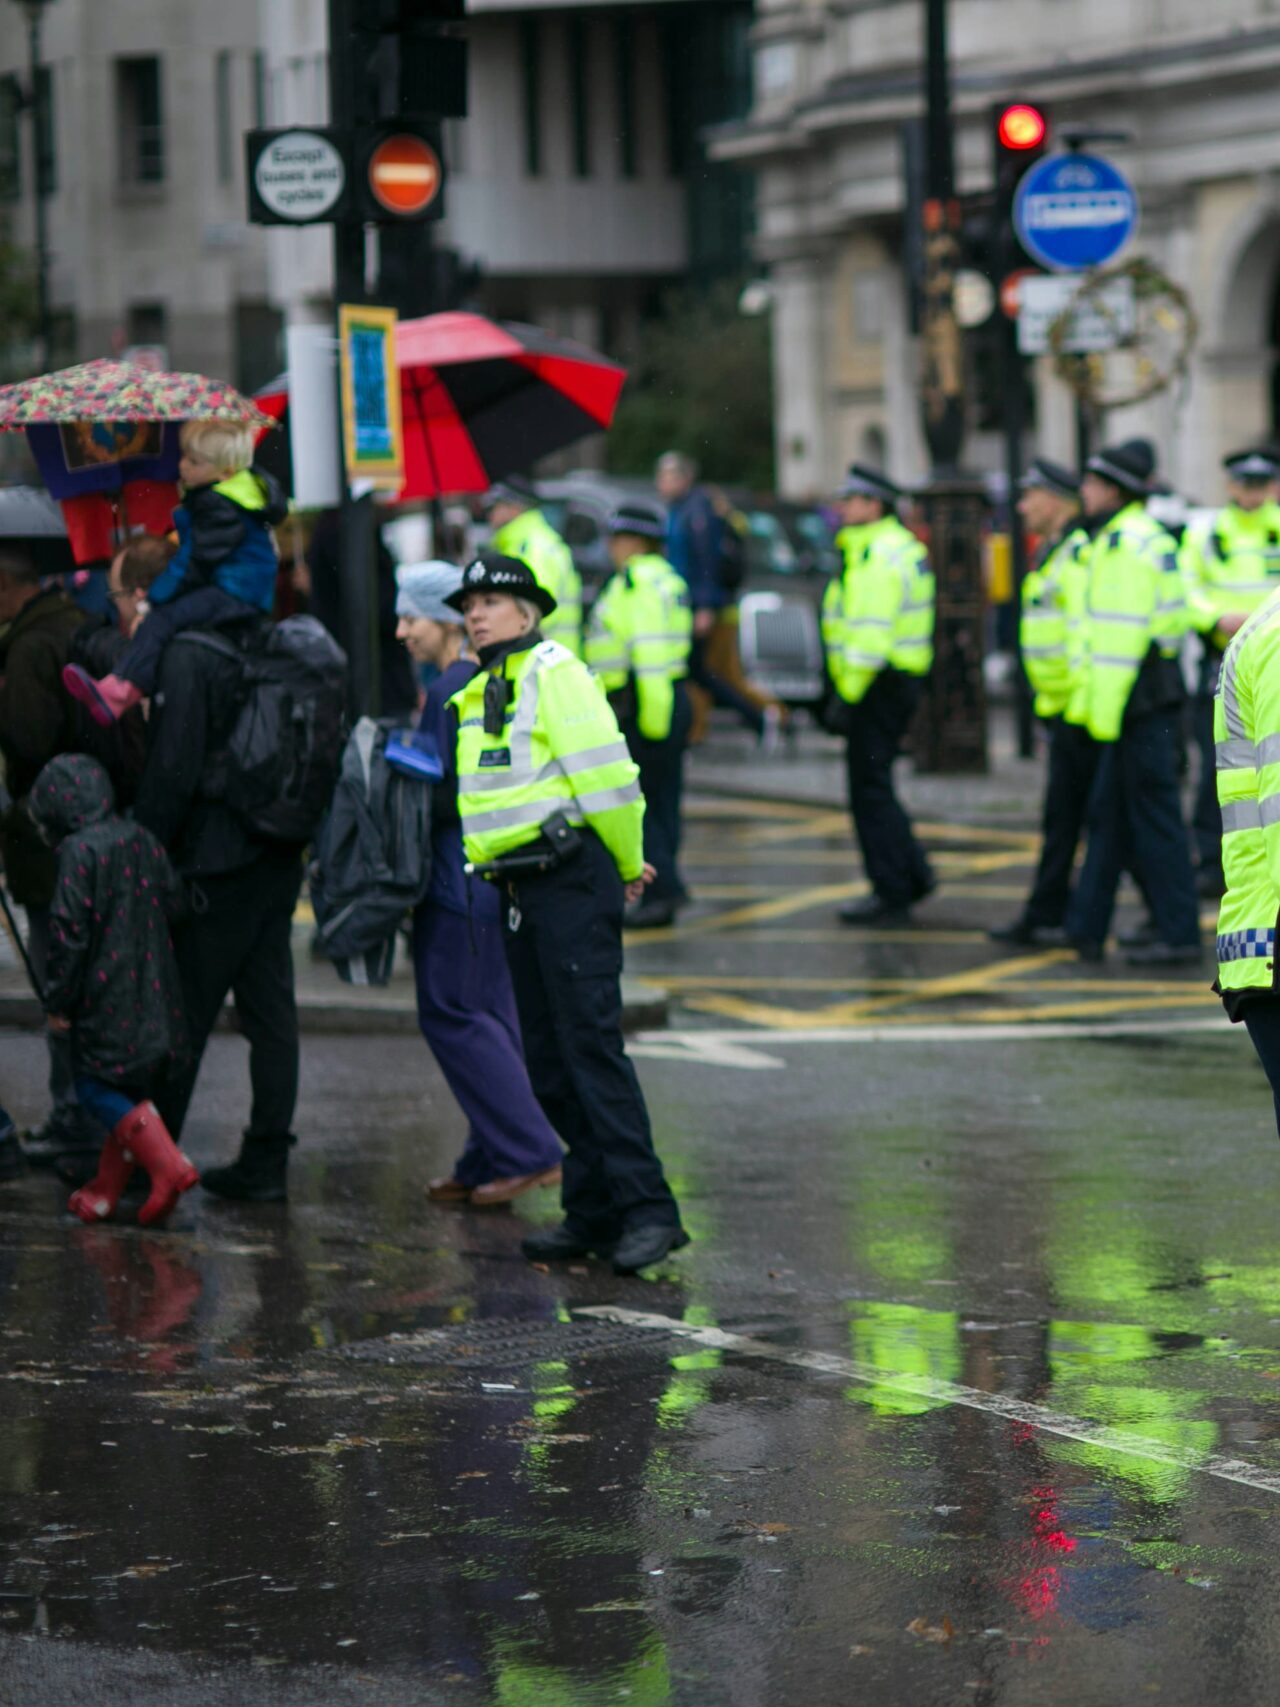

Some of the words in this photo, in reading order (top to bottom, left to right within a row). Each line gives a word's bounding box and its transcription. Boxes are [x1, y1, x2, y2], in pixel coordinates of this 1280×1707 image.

[272, 146, 324, 164] Except
[260, 169, 305, 184] buses
[311, 167, 338, 182] and
[276, 188, 325, 206] cycles
